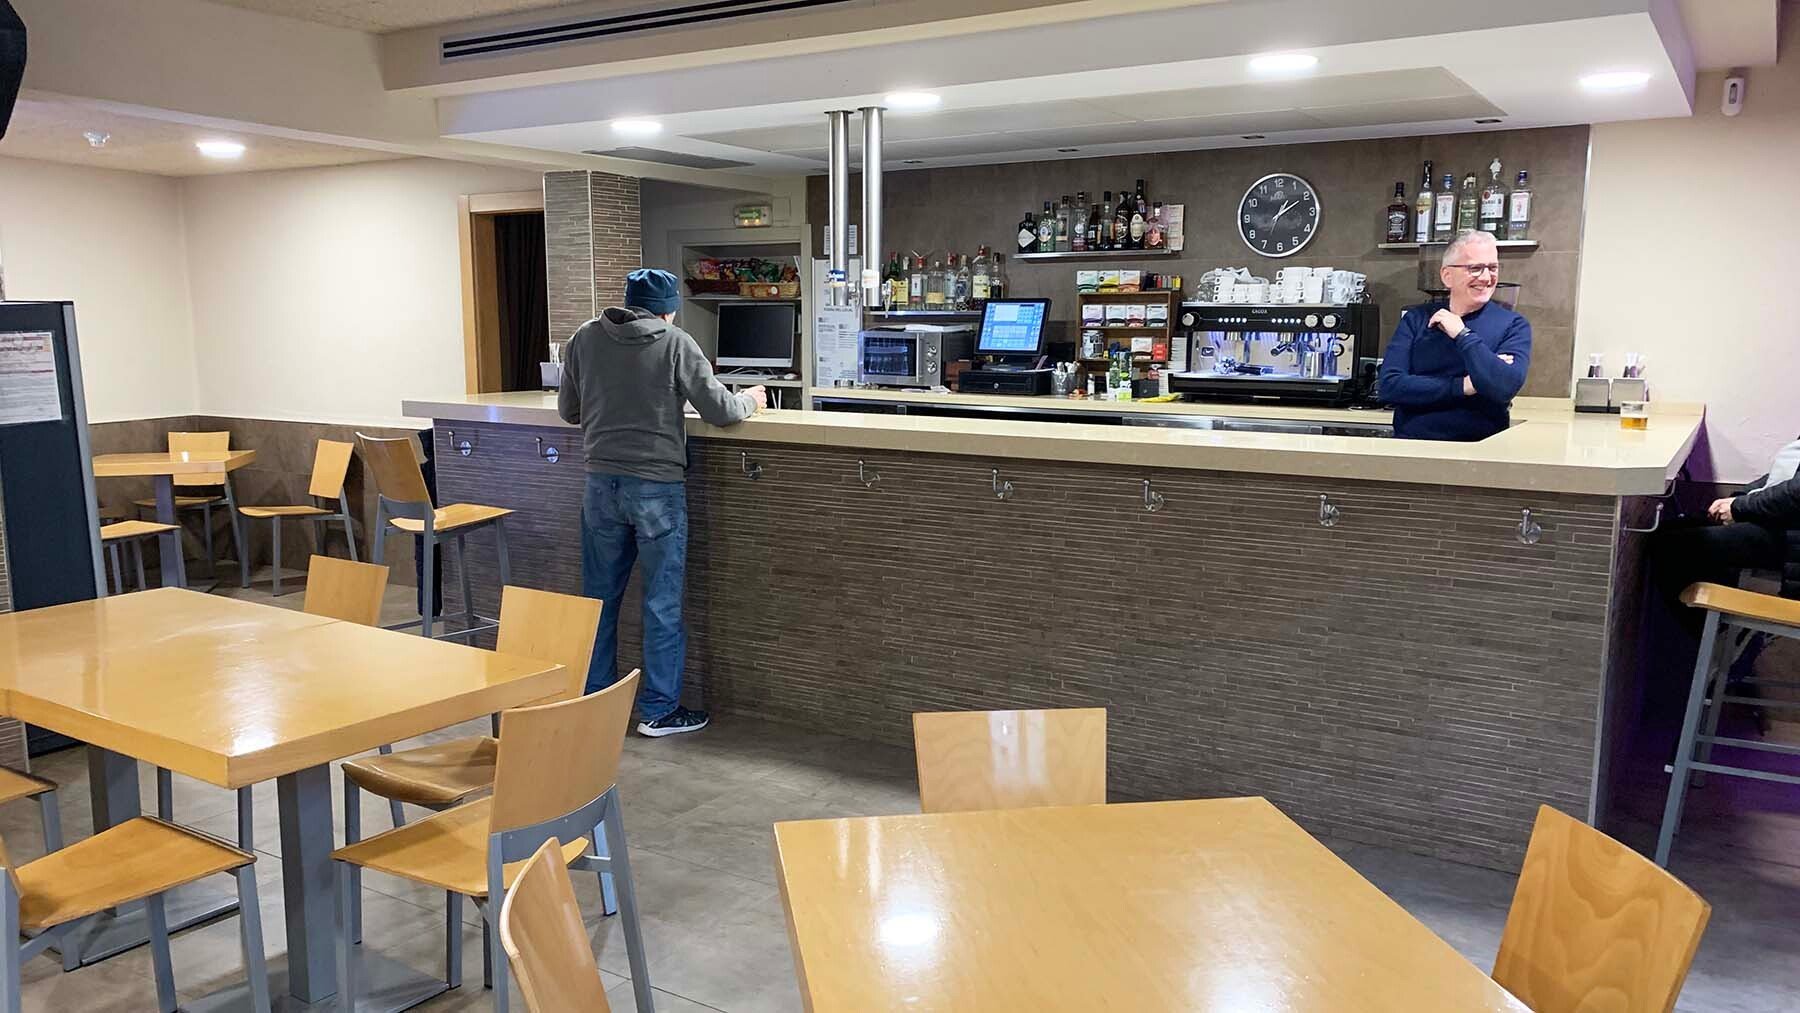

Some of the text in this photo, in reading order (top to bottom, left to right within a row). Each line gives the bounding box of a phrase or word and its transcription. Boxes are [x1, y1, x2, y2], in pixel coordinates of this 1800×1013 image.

[1274, 178, 1284, 188] 12
[1292, 181, 1297, 190] 1
[1259, 185, 1268, 194] 11
[1303, 191, 1310, 201] 2
[1248, 198, 1258, 207] 10
[1309, 207, 1315, 217] 3
[1243, 214, 1251, 223] 9
[1303, 223, 1311, 233] 4
[1249, 230, 1256, 239] 8
[1261, 240, 1268, 249] 7
[1292, 236, 1299, 246] 5
[1276, 242, 1283, 252] 6
